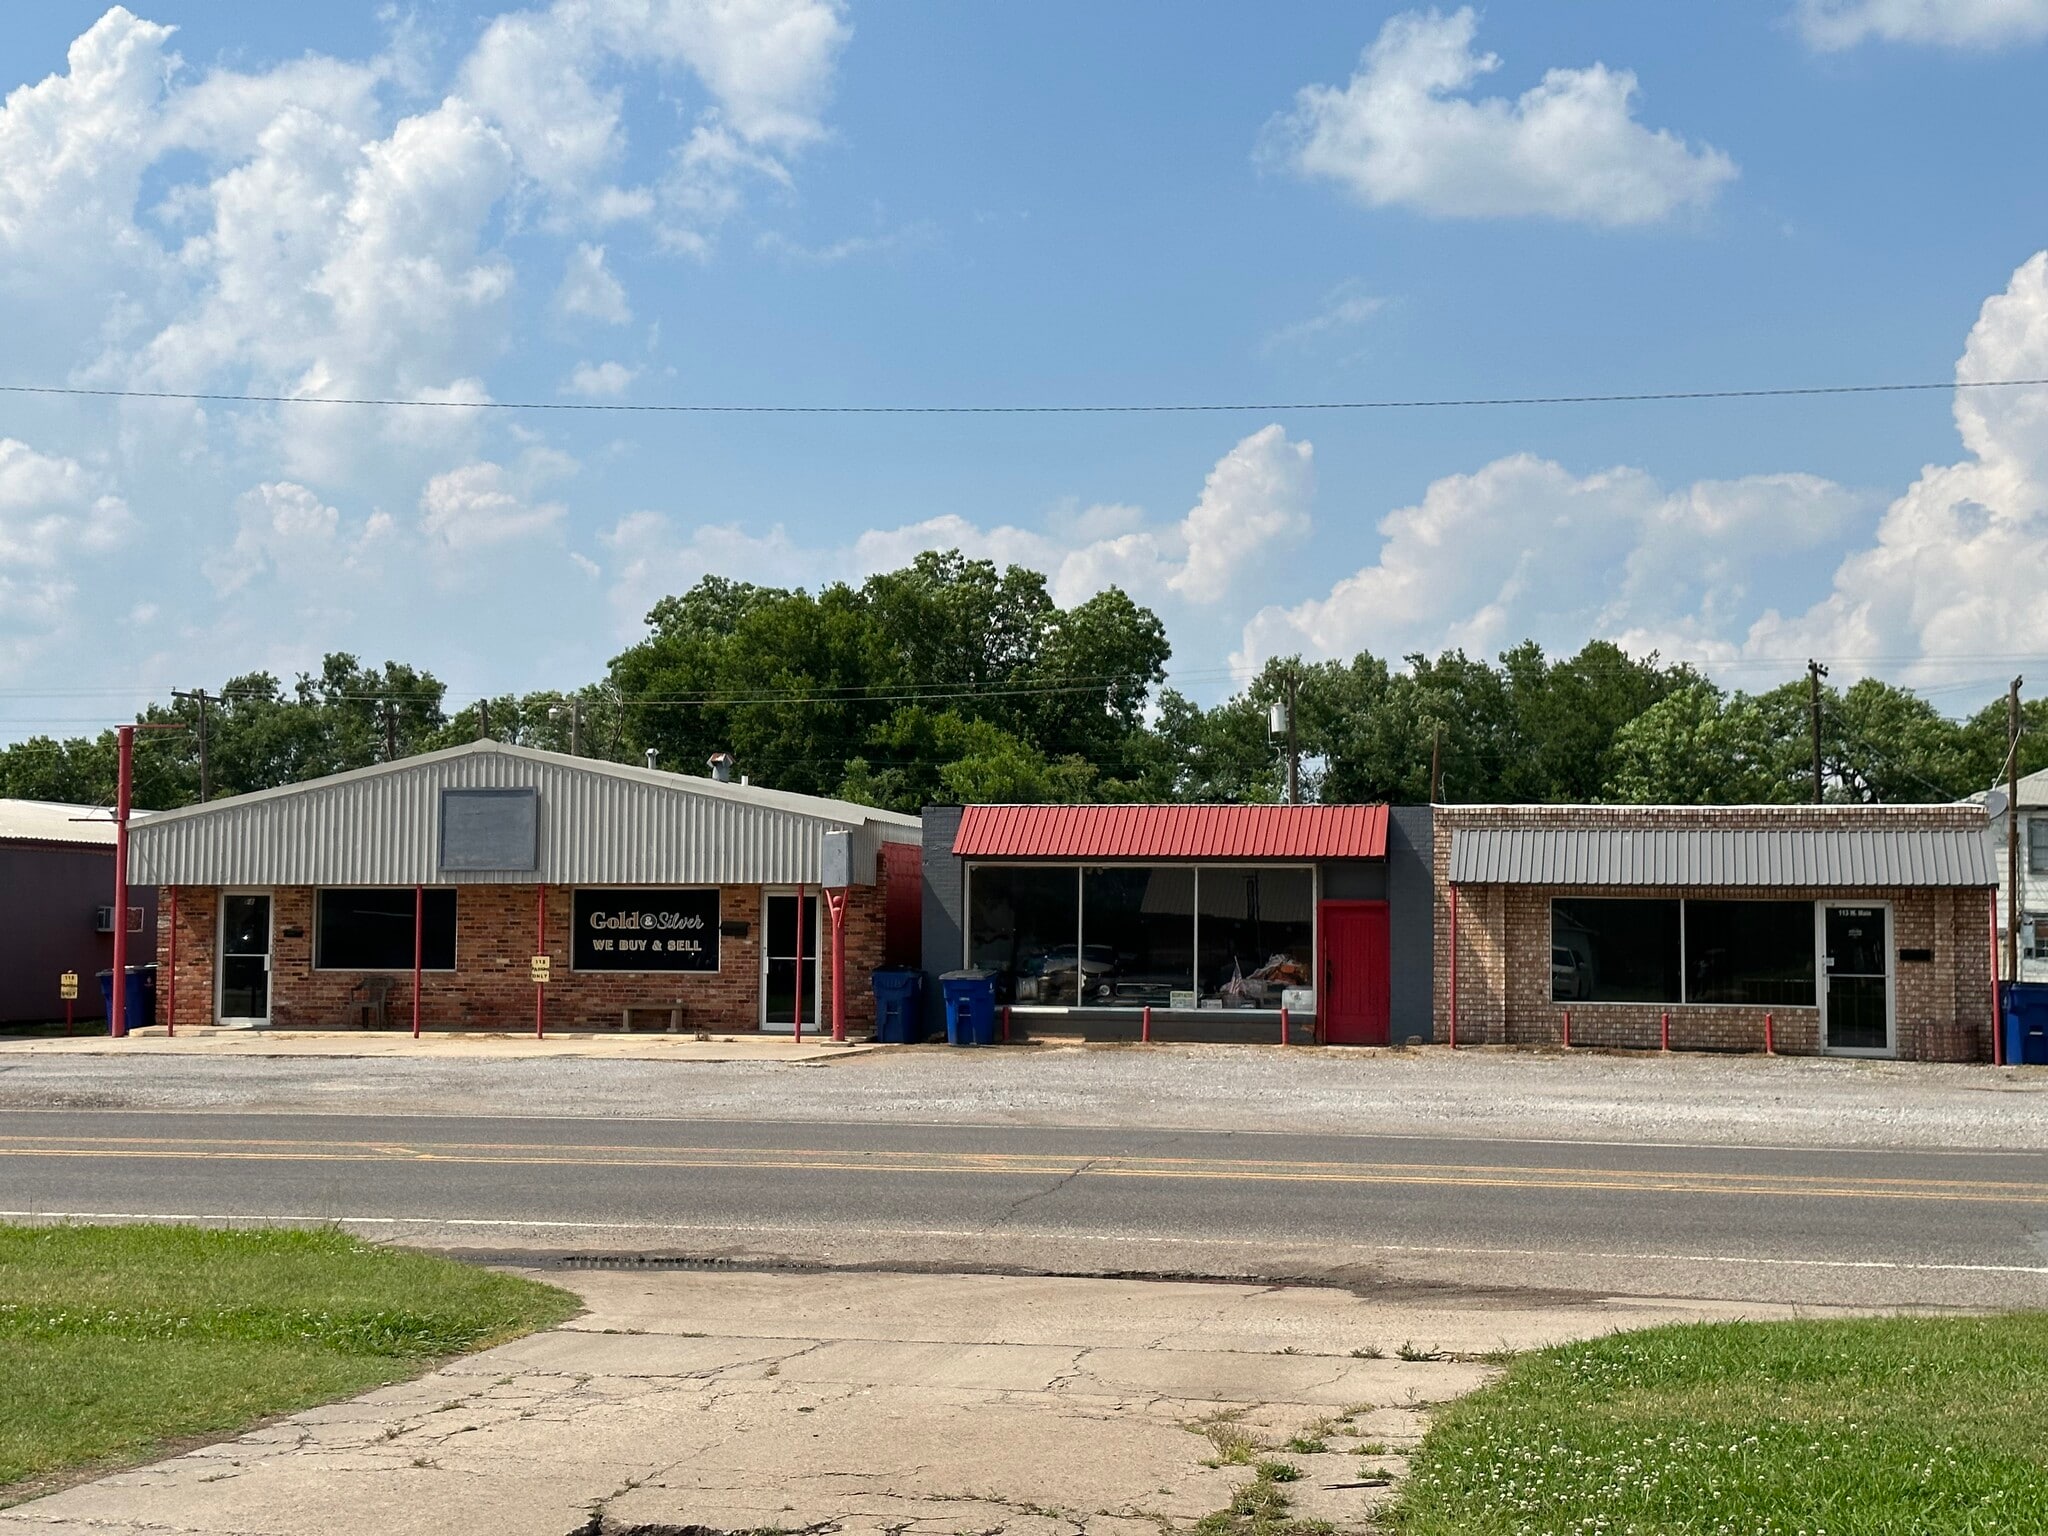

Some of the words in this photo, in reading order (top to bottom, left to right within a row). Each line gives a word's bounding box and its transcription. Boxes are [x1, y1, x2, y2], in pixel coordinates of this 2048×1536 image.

[590, 911, 641, 930] Gold
[656, 911, 704, 930] Silver
[592, 939, 614, 951] WE
[618, 939, 647, 951] BUY
[651, 940, 662, 951] &
[667, 939, 702, 951] SELL
